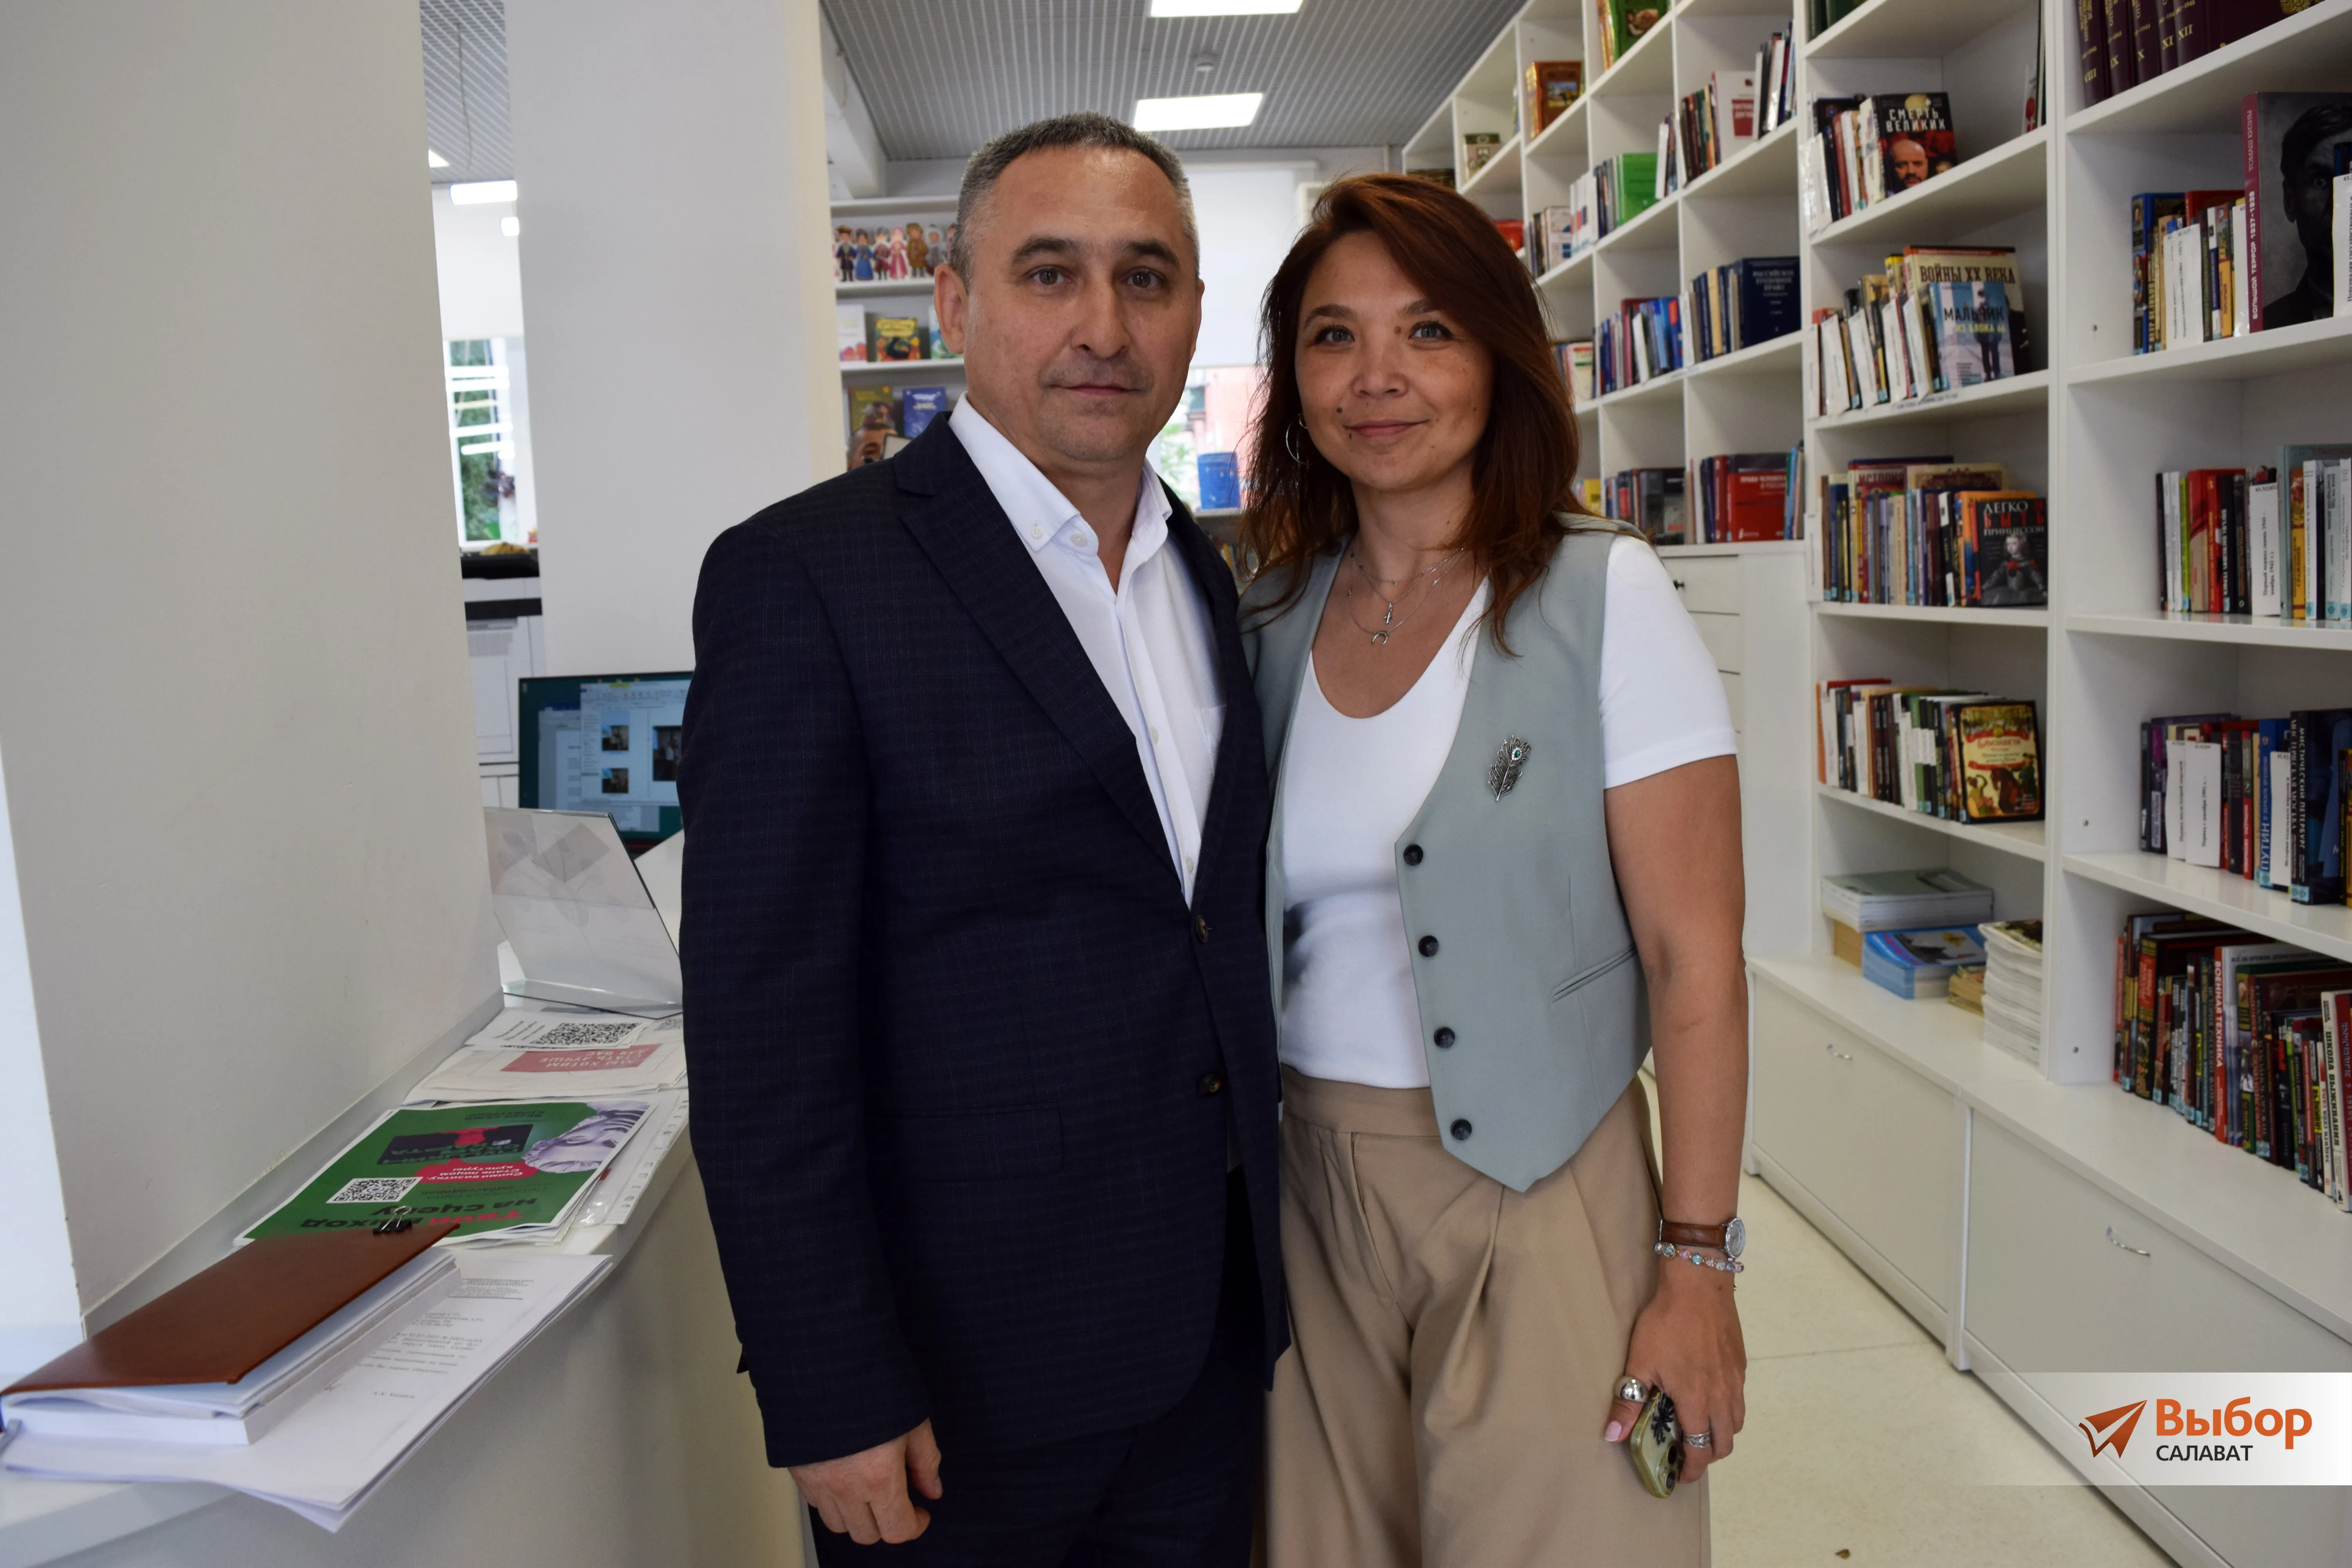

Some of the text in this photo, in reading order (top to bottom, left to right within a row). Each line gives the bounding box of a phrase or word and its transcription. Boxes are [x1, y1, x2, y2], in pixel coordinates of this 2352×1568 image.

[2178, 24, 2193, 41] XII
[2162, 35, 2174, 50] XI
[2137, 49, 2145, 61] X
[1889, 107, 1939, 121] СМЕРТЬ
[1886, 118, 1946, 132] ВЕЛИКИХ
[1920, 263, 2016, 284] ВОЙНЫ XX ВЕКА
[1944, 307, 2005, 321] МАЛЬЧИК
[1984, 501, 2028, 514] ЛЕГКО
[1984, 511, 2044, 529] БЫТЬ
[2261, 822, 2270, 871] ПУТИН
[2325, 1031, 2339, 1146] ШКОЛА ВЫЖИВАНИЯ
[492, 1197, 538, 1210] на
[427, 1209, 523, 1225] Твой
